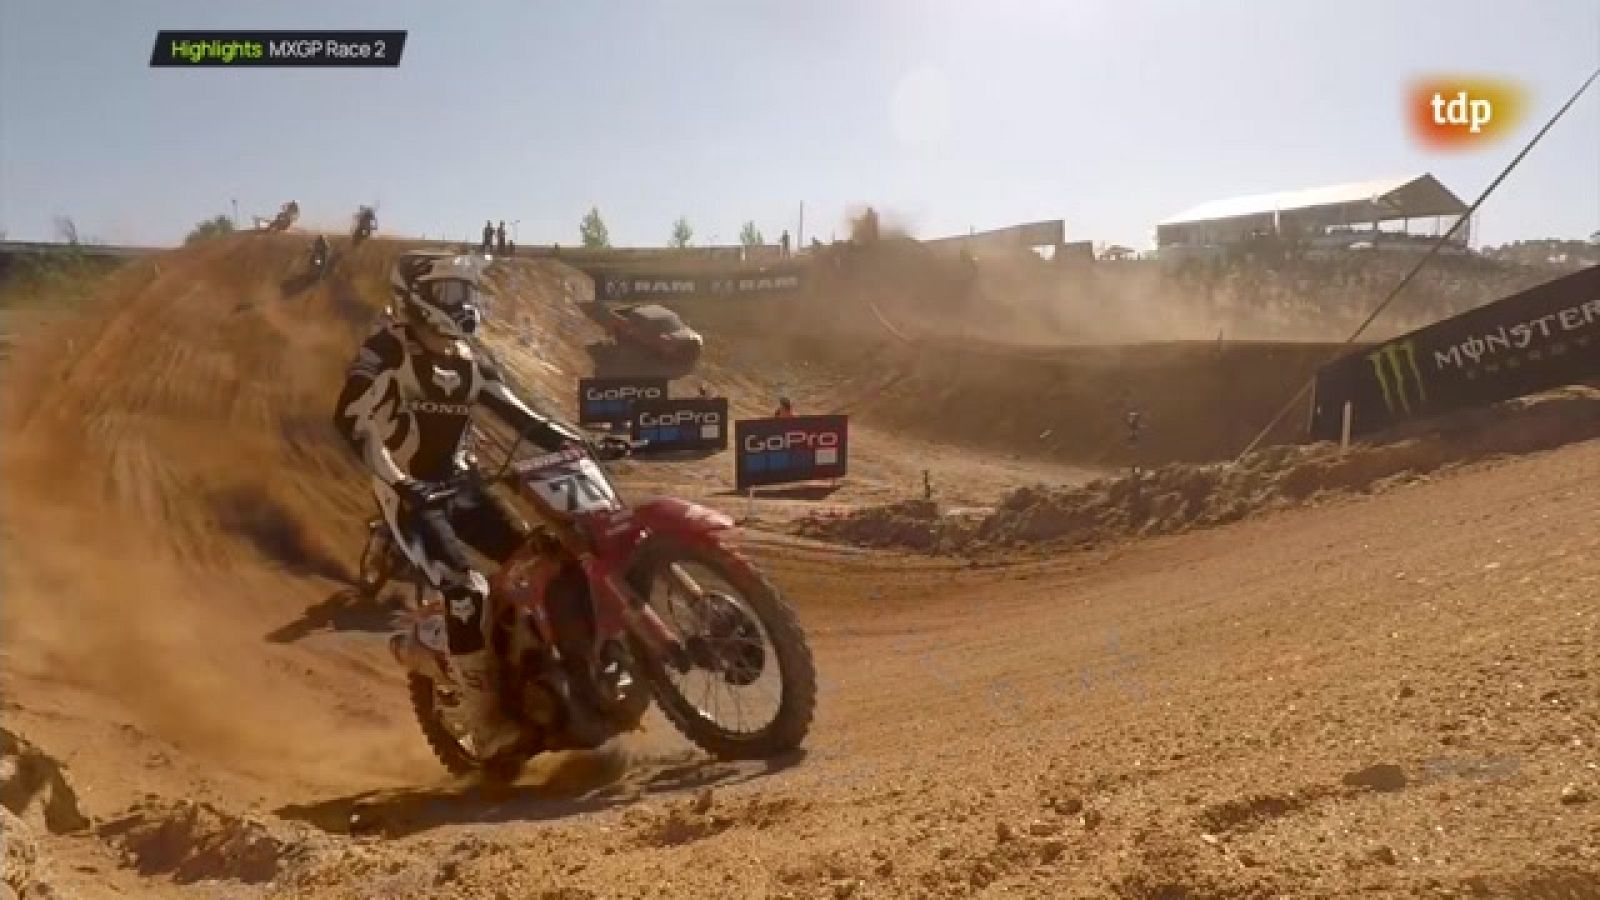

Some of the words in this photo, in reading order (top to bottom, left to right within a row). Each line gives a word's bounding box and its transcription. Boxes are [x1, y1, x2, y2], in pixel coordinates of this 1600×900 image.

[586, 387, 661, 401] GoPro
[639, 410, 721, 426] GoPro
[744, 431, 839, 451] GoPro
